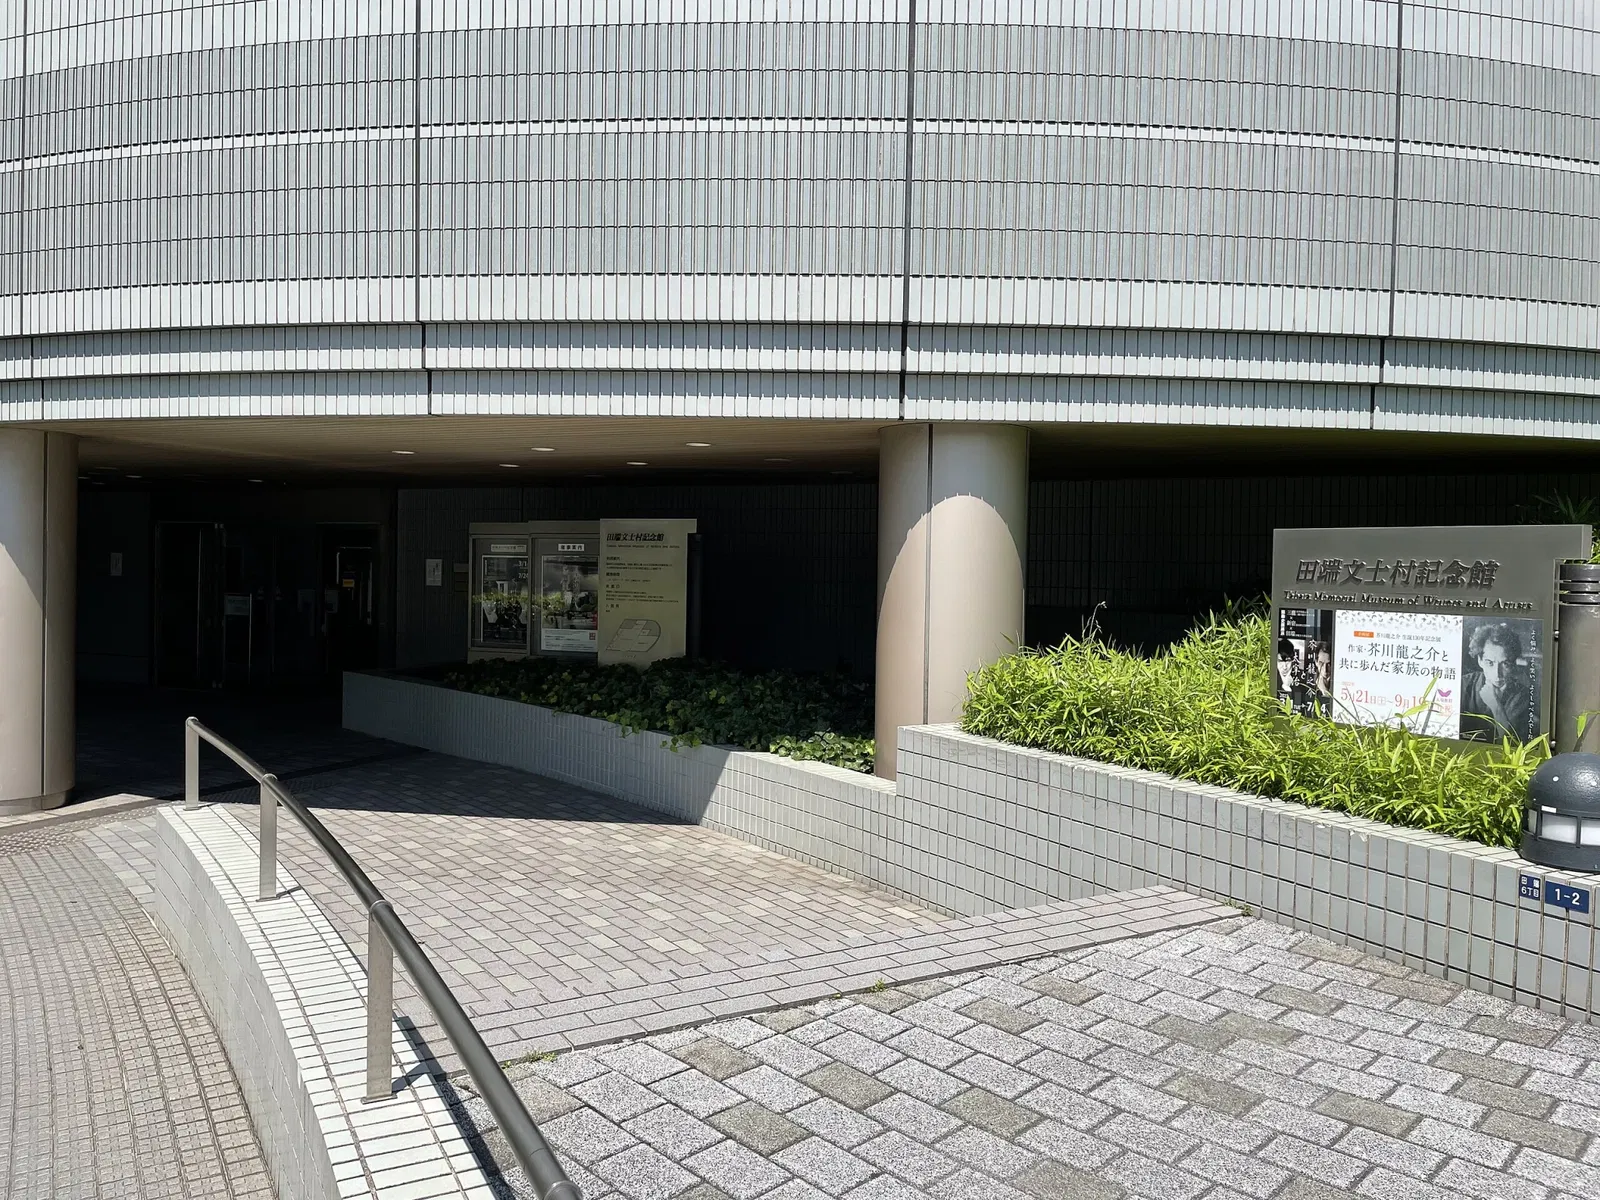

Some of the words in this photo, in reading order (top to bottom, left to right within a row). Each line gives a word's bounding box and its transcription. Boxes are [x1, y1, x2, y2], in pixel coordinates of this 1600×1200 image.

[1296, 557, 1500, 590] 田端文士村記念館
[1314, 591, 1357, 603] Memorial
[1360, 593, 1404, 605] Museum
[1408, 594, 1420, 606] of
[1423, 595, 1463, 608] Writers
[1466, 597, 1488, 609] and
[1492, 597, 1532, 611] Artists
[1291, 652, 1301, 686] 太宰治
[1338, 657, 1456, 681] 共に歩んだ家族の物語
[1554, 888, 1581, 906] 1-2
